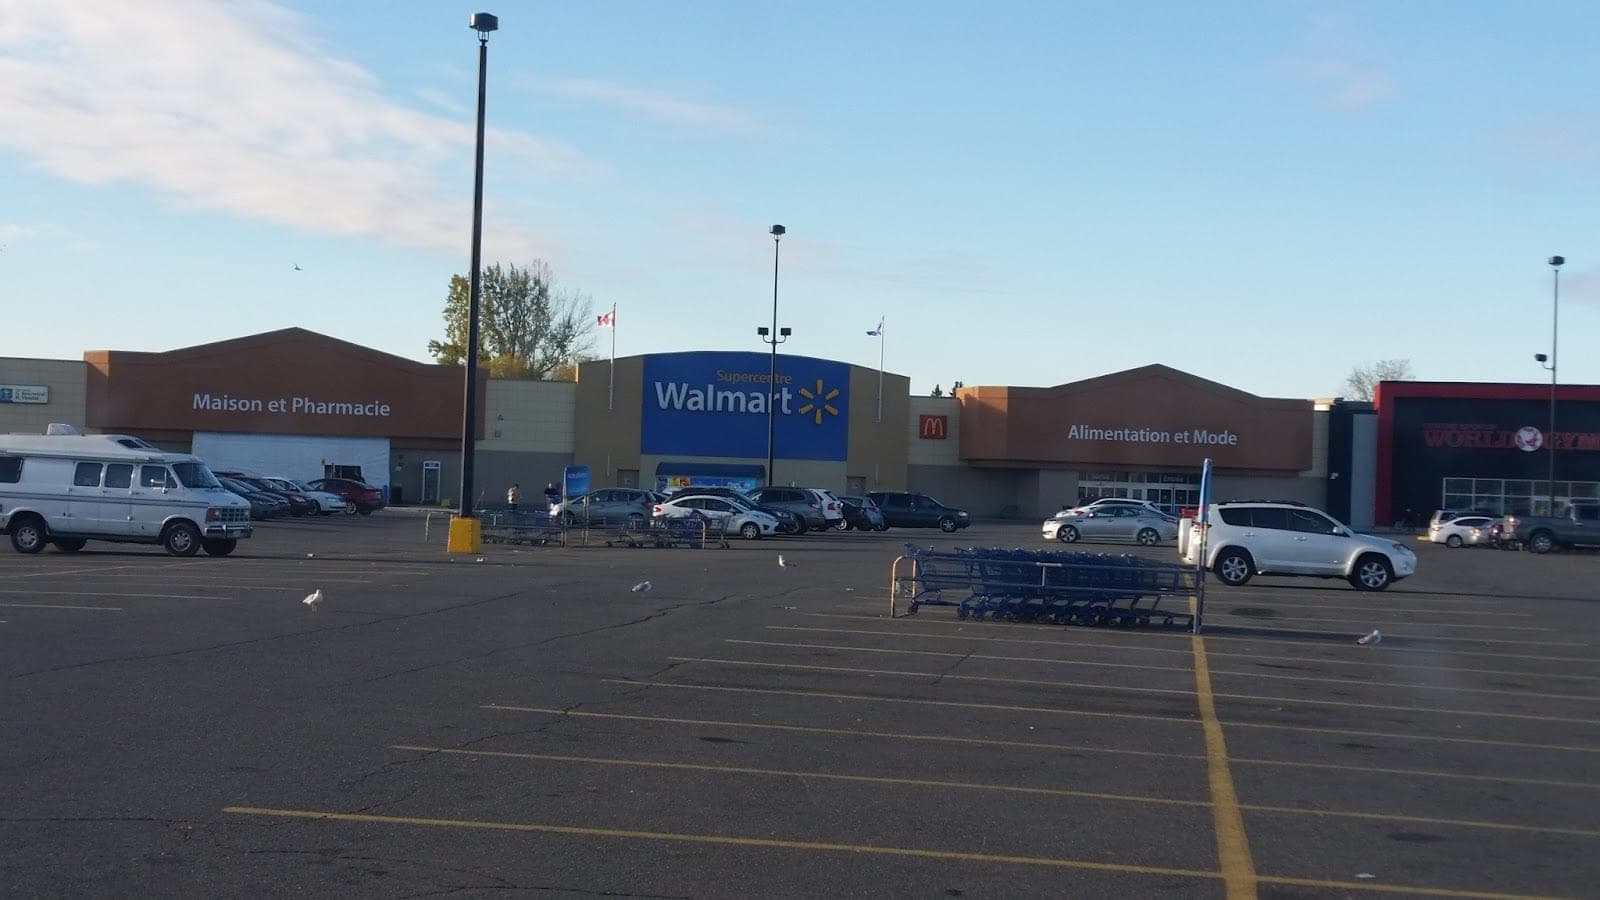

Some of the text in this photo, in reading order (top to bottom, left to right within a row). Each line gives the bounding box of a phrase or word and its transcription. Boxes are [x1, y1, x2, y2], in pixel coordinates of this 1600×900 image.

[193, 394, 390, 416] Maison et Pharmacie
[655, 382, 792, 415] Walmart
[1068, 425, 1238, 445] Alimentation et Mode
